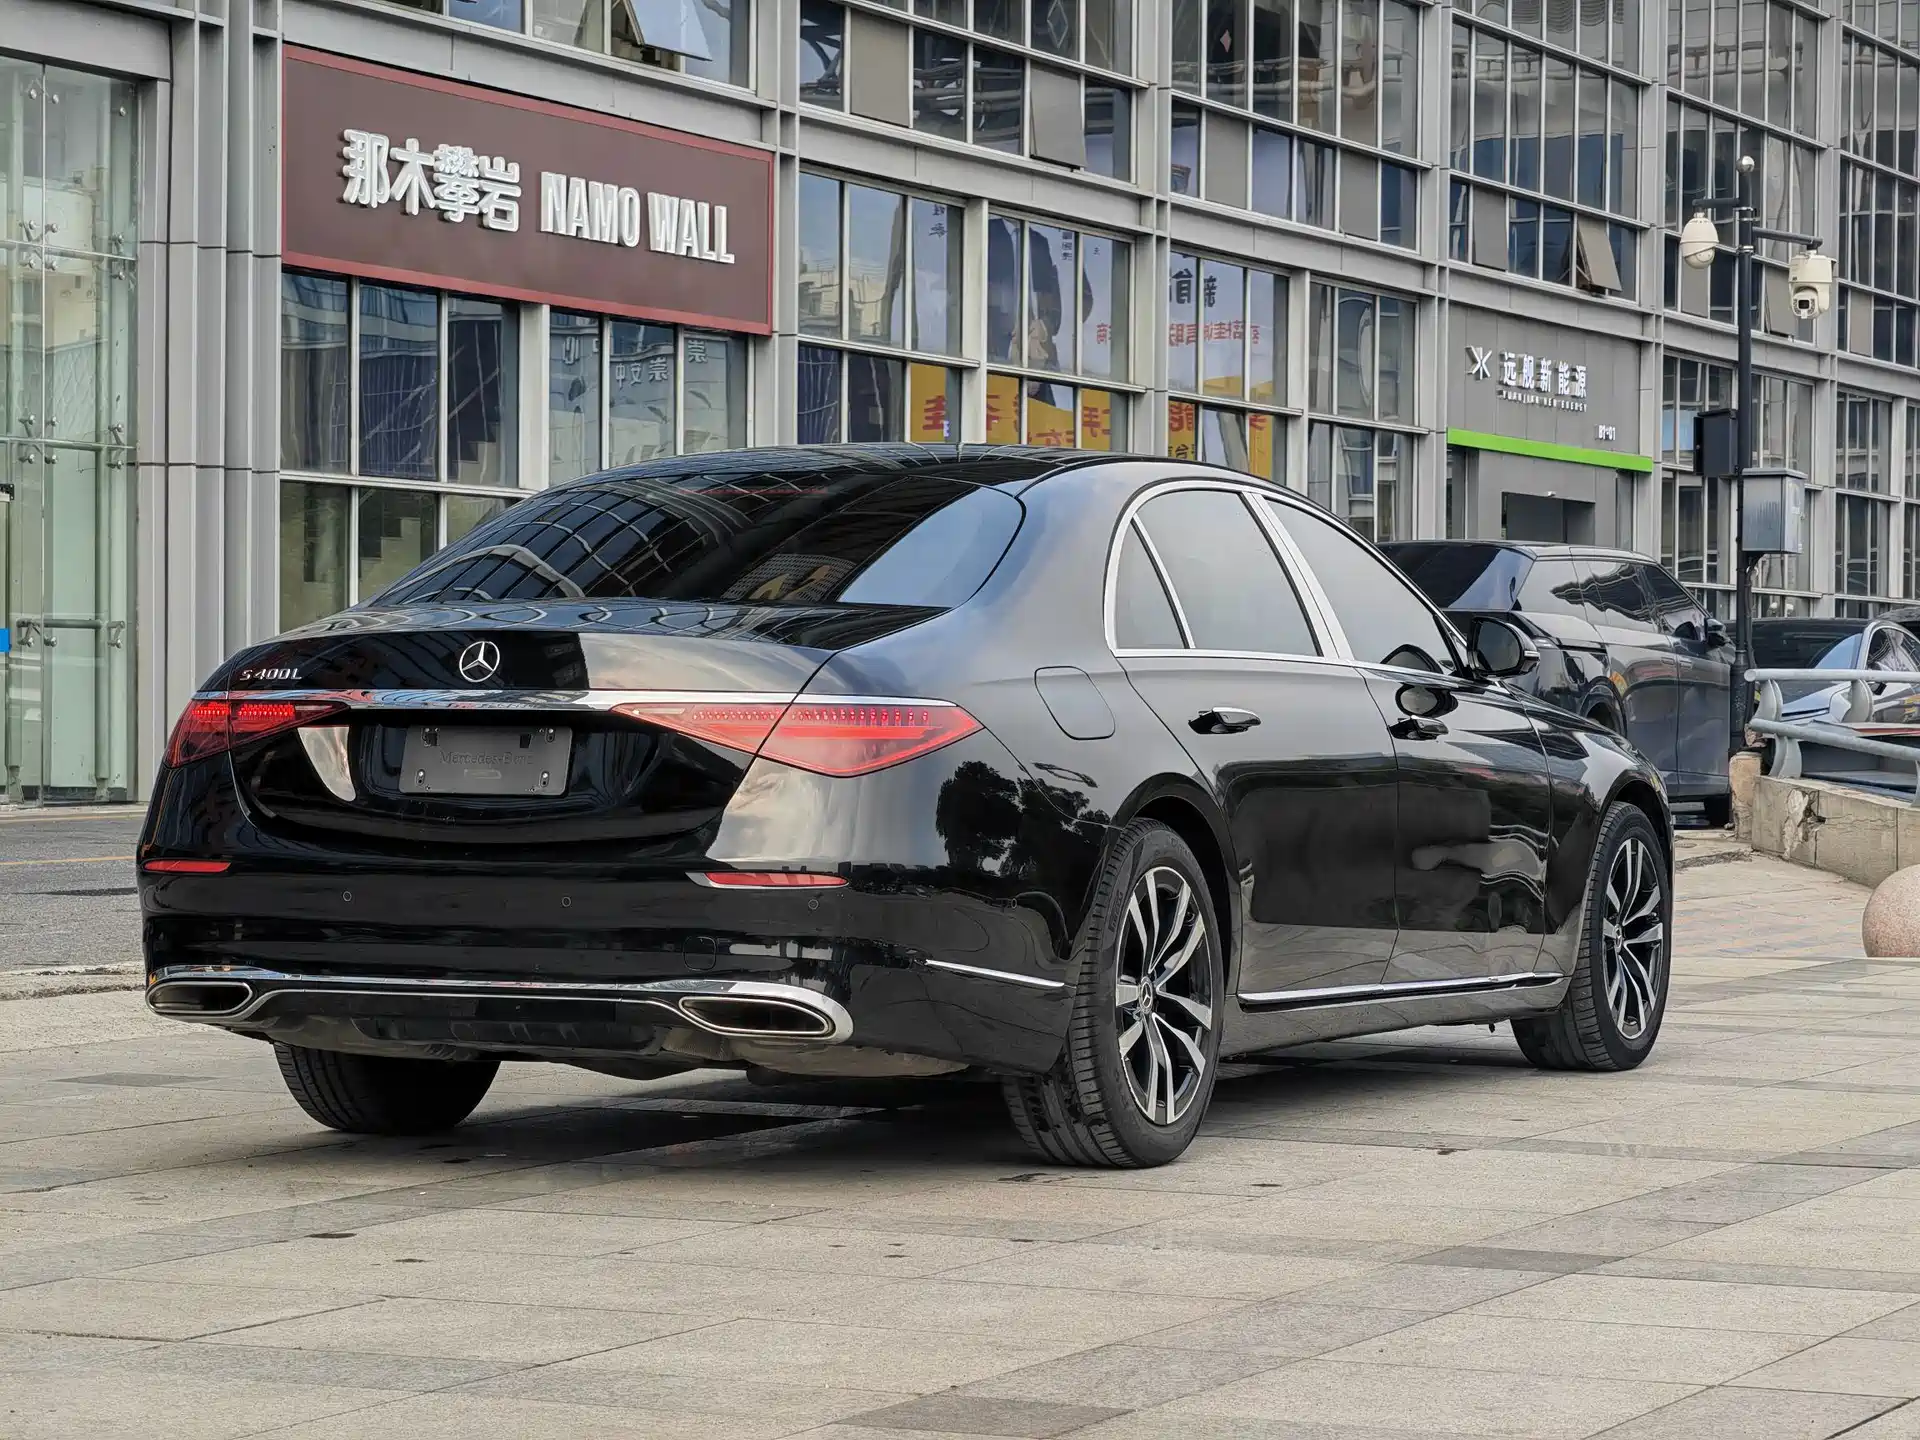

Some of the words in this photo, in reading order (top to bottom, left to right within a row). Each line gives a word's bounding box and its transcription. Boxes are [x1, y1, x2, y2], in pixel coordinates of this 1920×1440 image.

[342, 128, 522, 232] 那木攀岩
[540, 171, 640, 248] NAMO
[647, 191, 735, 264] WALL
[1502, 351, 1587, 398] 远舰新能源
